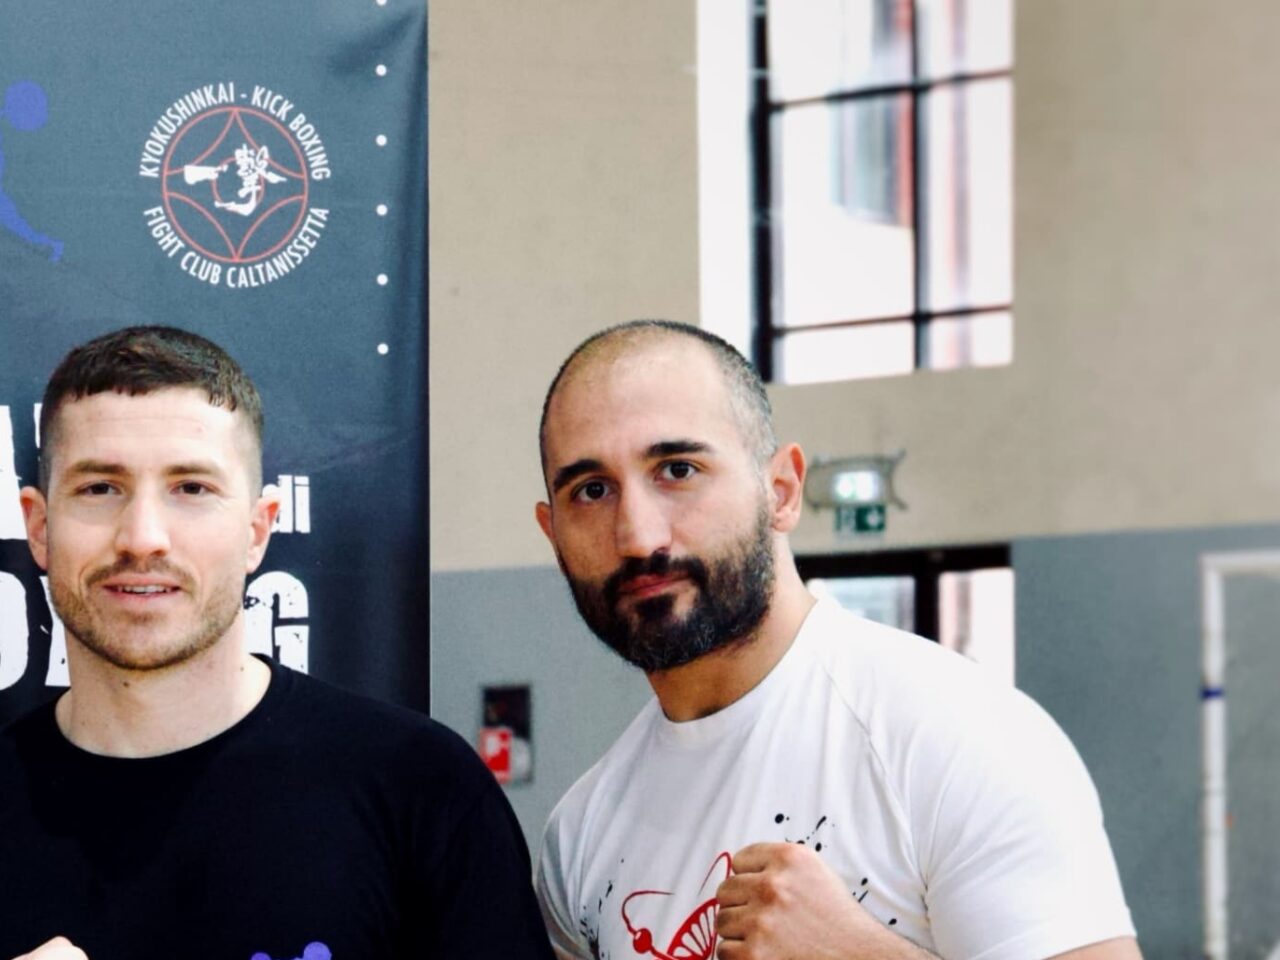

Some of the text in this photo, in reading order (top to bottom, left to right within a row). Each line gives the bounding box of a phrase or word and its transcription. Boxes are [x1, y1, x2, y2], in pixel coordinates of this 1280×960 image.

[139, 82, 234, 177] KYOKUSHINKAI
[251, 86, 294, 121] KICK
[289, 113, 331, 181] BOXING
[144, 206, 330, 288] FIGHT CLUB CALTANISSETTA
